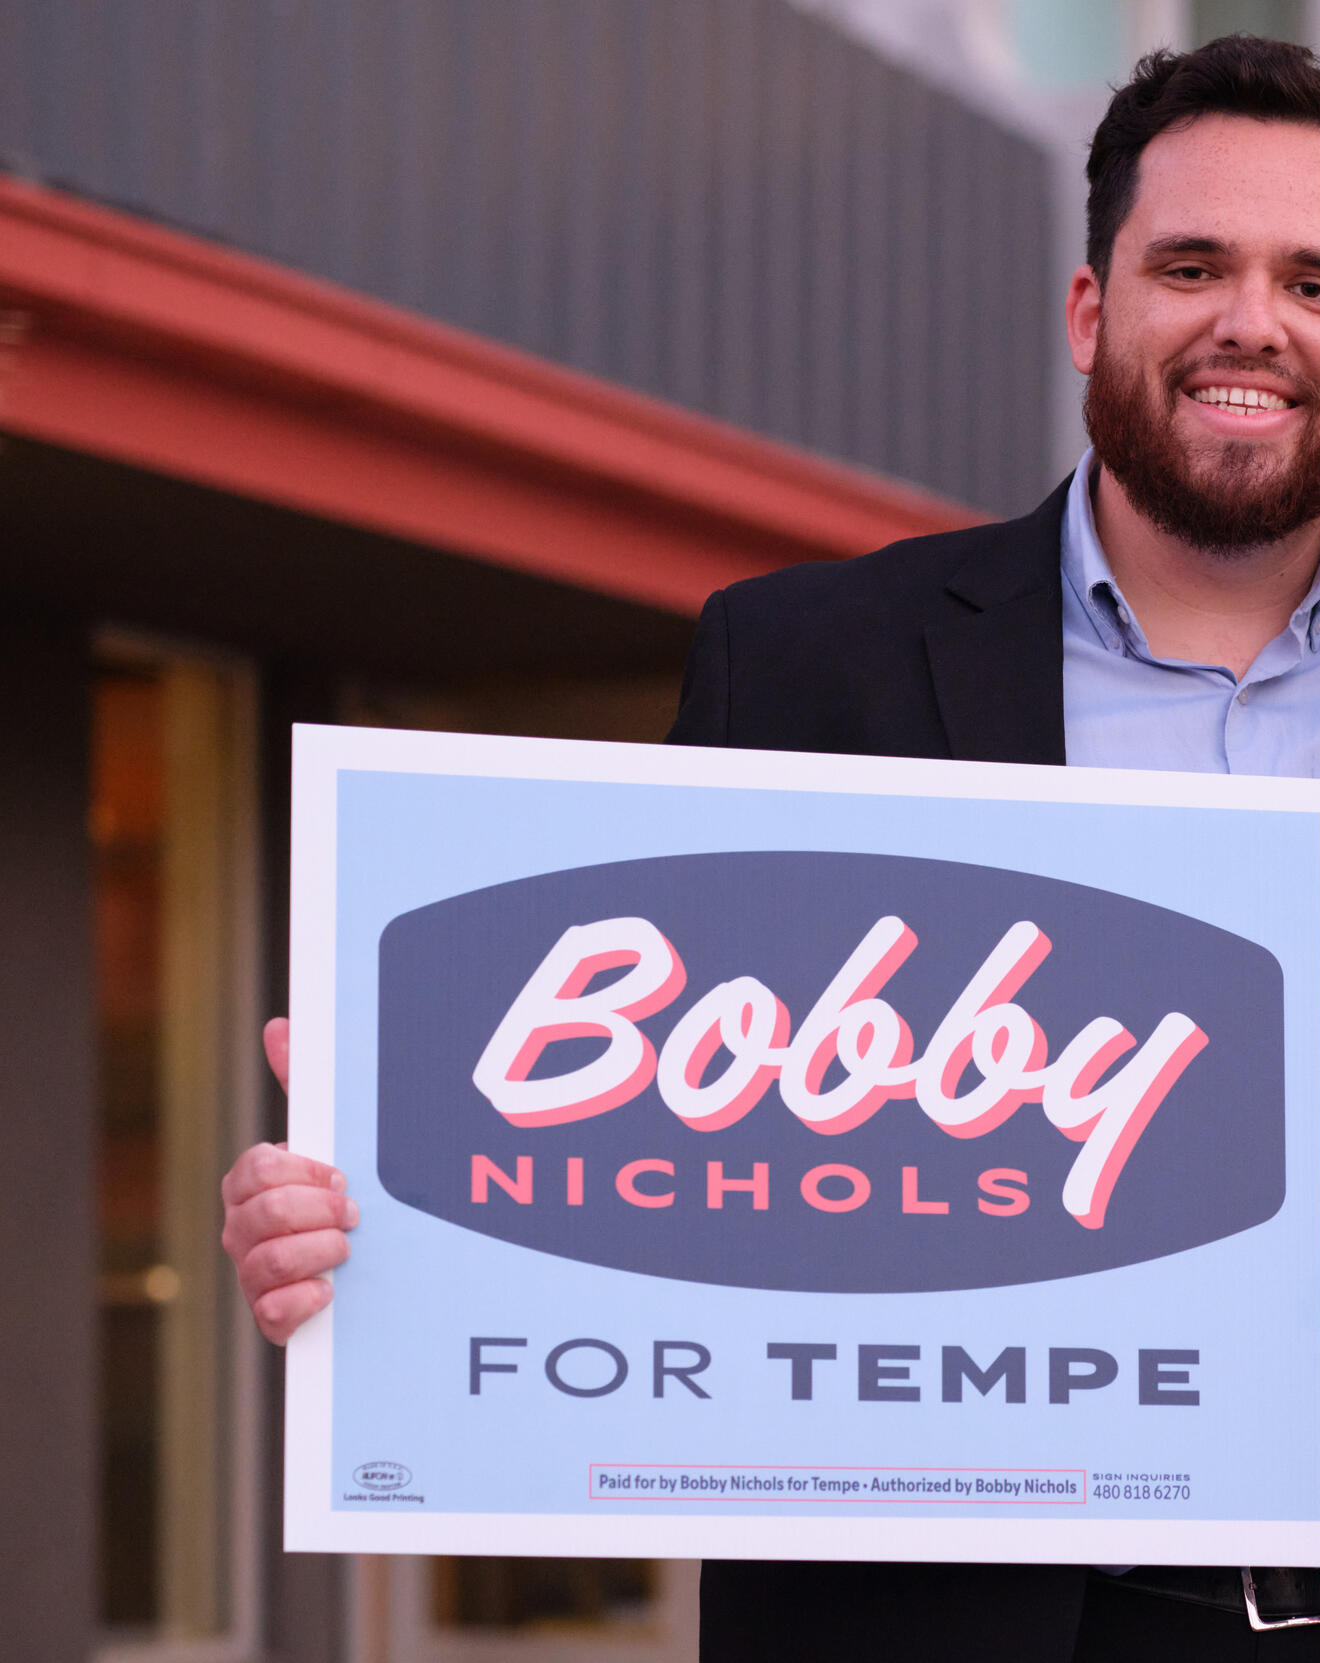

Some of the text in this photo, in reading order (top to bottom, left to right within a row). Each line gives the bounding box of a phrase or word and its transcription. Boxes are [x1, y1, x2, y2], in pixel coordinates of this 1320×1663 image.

[472, 916, 1208, 1229] Bobby
[471, 1154, 1031, 1217] NICHOLS
[469, 1337, 1200, 1406] FOR TEMPE
[599, 1474, 1077, 1496] Paid for by Bobby Nichols for Tempe Authorized by Bobby Nichols
[1092, 1473, 1191, 1482] SIGN INQUIRIES
[343, 1492, 424, 1504] Looks Good Printing
[1093, 1484, 1191, 1500] 480 818 6270
